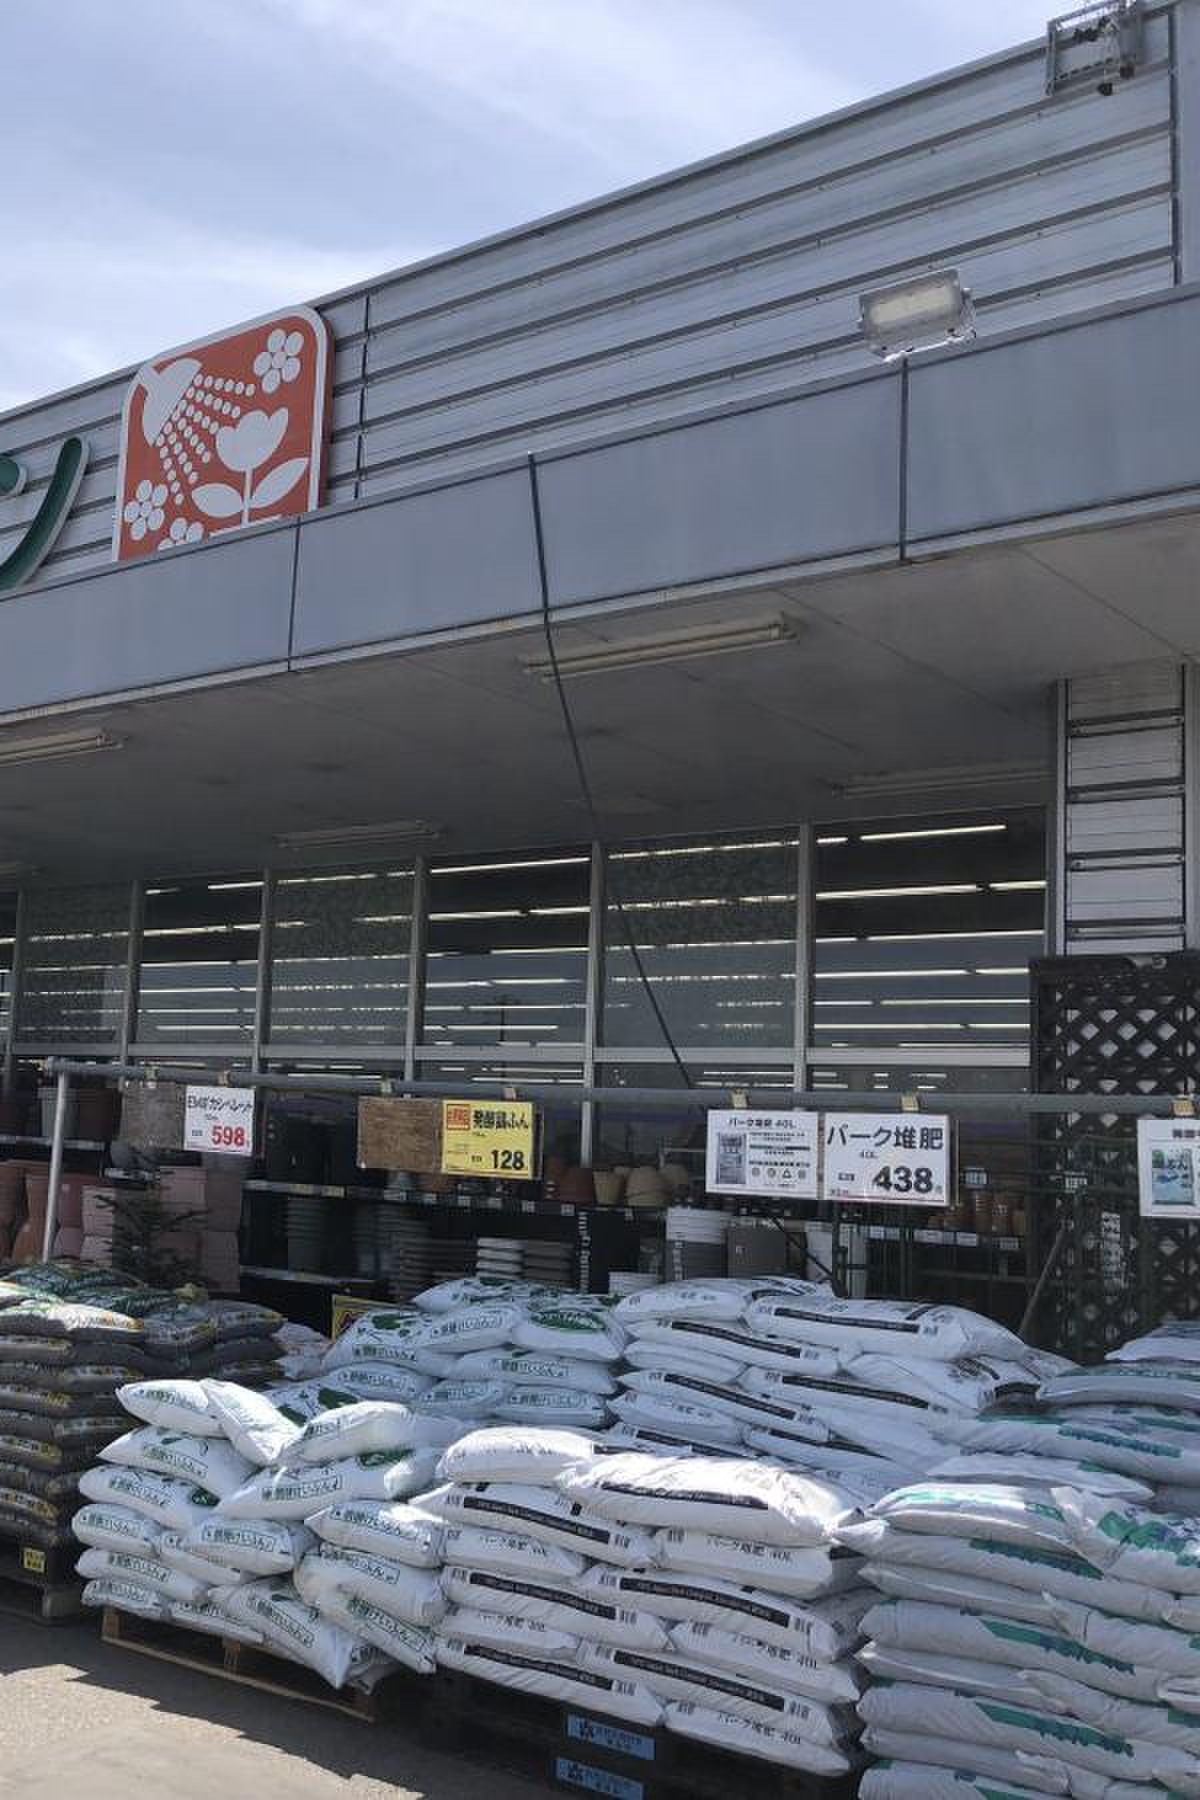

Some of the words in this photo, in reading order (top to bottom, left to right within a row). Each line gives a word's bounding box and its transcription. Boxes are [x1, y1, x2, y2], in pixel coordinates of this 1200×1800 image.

[211, 1125, 245, 1147] 598
[826, 1124, 944, 1150] バーク堆肥
[491, 1150, 525, 1171] 128
[872, 1165, 934, 1193] 438
